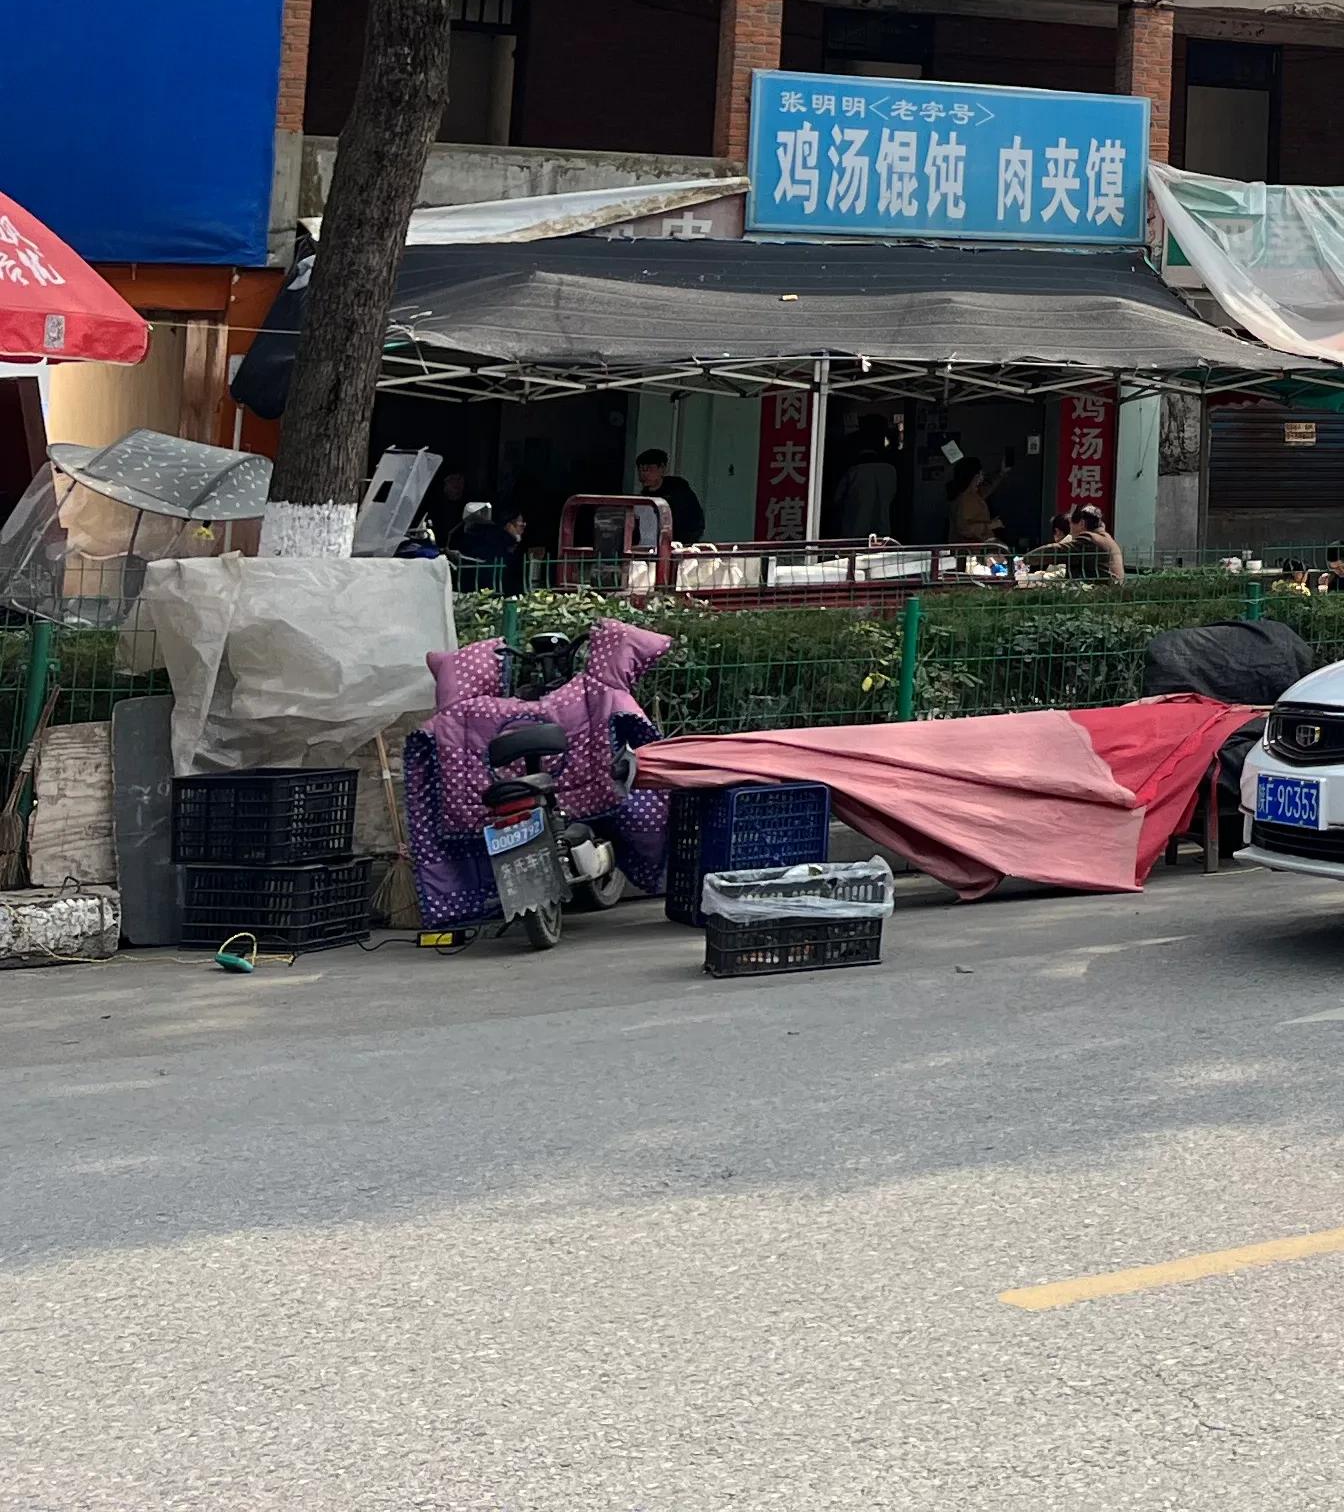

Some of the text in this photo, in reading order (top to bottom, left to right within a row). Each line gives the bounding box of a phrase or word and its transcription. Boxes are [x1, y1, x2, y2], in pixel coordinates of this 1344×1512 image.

[774, 122, 1126, 227] 鸡汤馄饨 肉夹馍
[1067, 392, 1112, 523] 鸡汤馄
